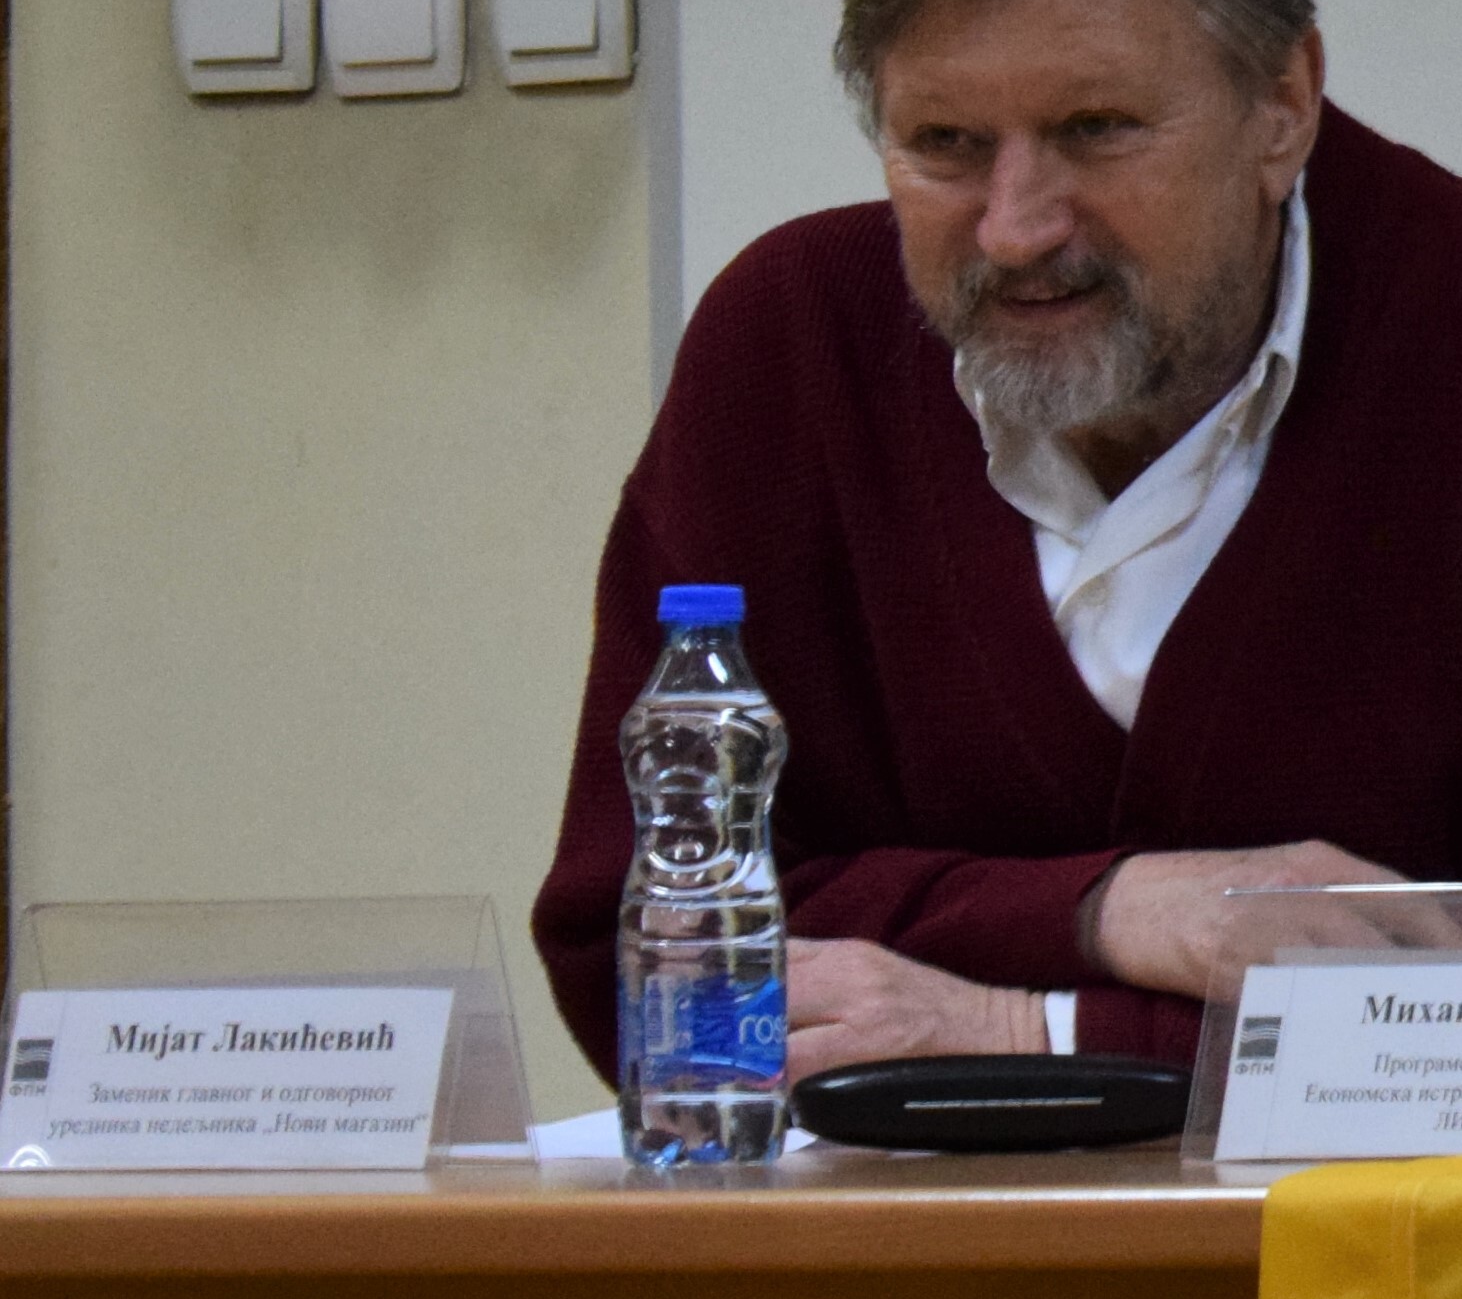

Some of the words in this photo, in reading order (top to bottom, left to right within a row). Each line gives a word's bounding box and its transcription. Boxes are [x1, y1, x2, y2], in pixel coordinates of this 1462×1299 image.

[106, 1023, 205, 1061] Мијат
[212, 1020, 395, 1053] Лакићевић
[739, 1014, 787, 1045] ros
[89, 1082, 172, 1103] Заменик
[261, 1087, 273, 1101] и
[279, 1086, 395, 1106] одговорног
[1304, 1083, 1413, 1104] Економска
